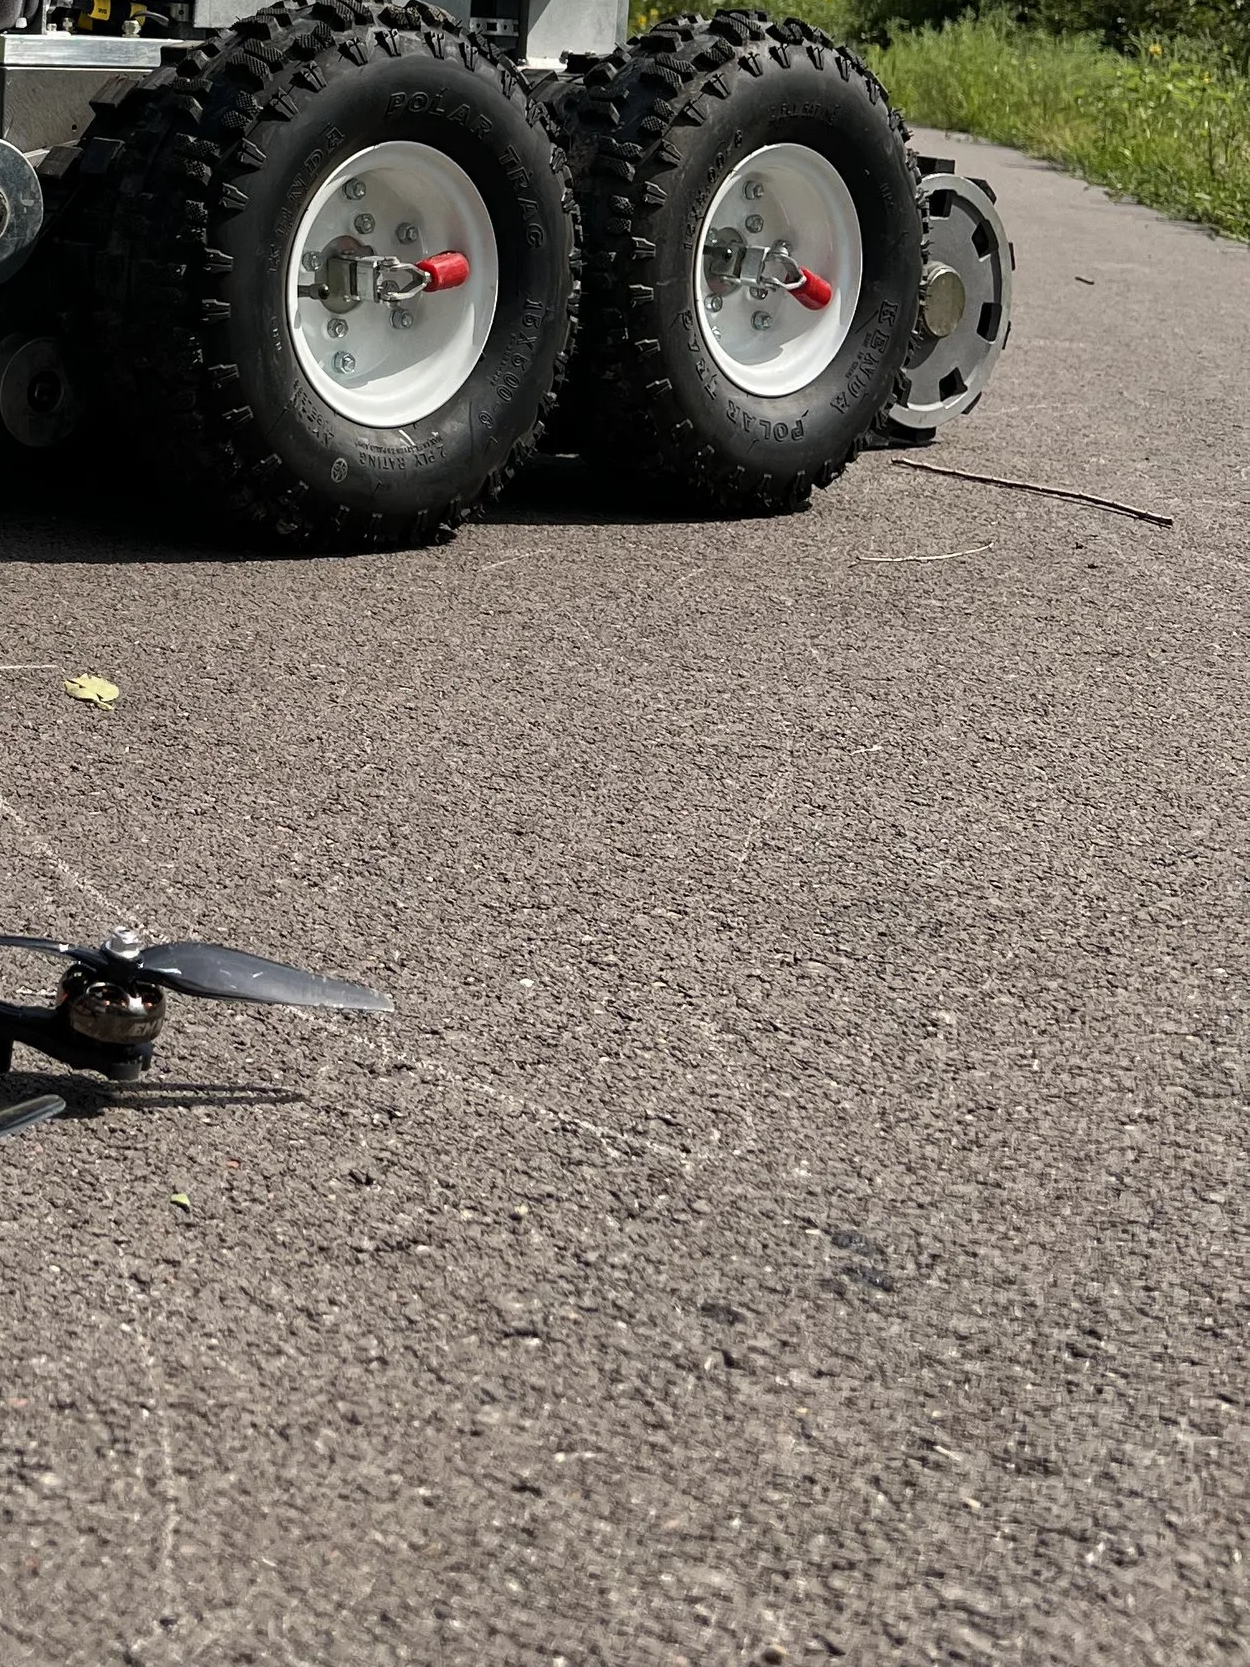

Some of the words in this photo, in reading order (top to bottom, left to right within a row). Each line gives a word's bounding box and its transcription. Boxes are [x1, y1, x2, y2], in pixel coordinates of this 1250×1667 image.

[384, 90, 493, 141] POLAR
[498, 144, 546, 249] TRAC
[829, 299, 900, 416] KENDA
[726, 400, 805, 444] POLAR
[357, 451, 406, 471] RATING
[413, 450, 435, 468] PLY
